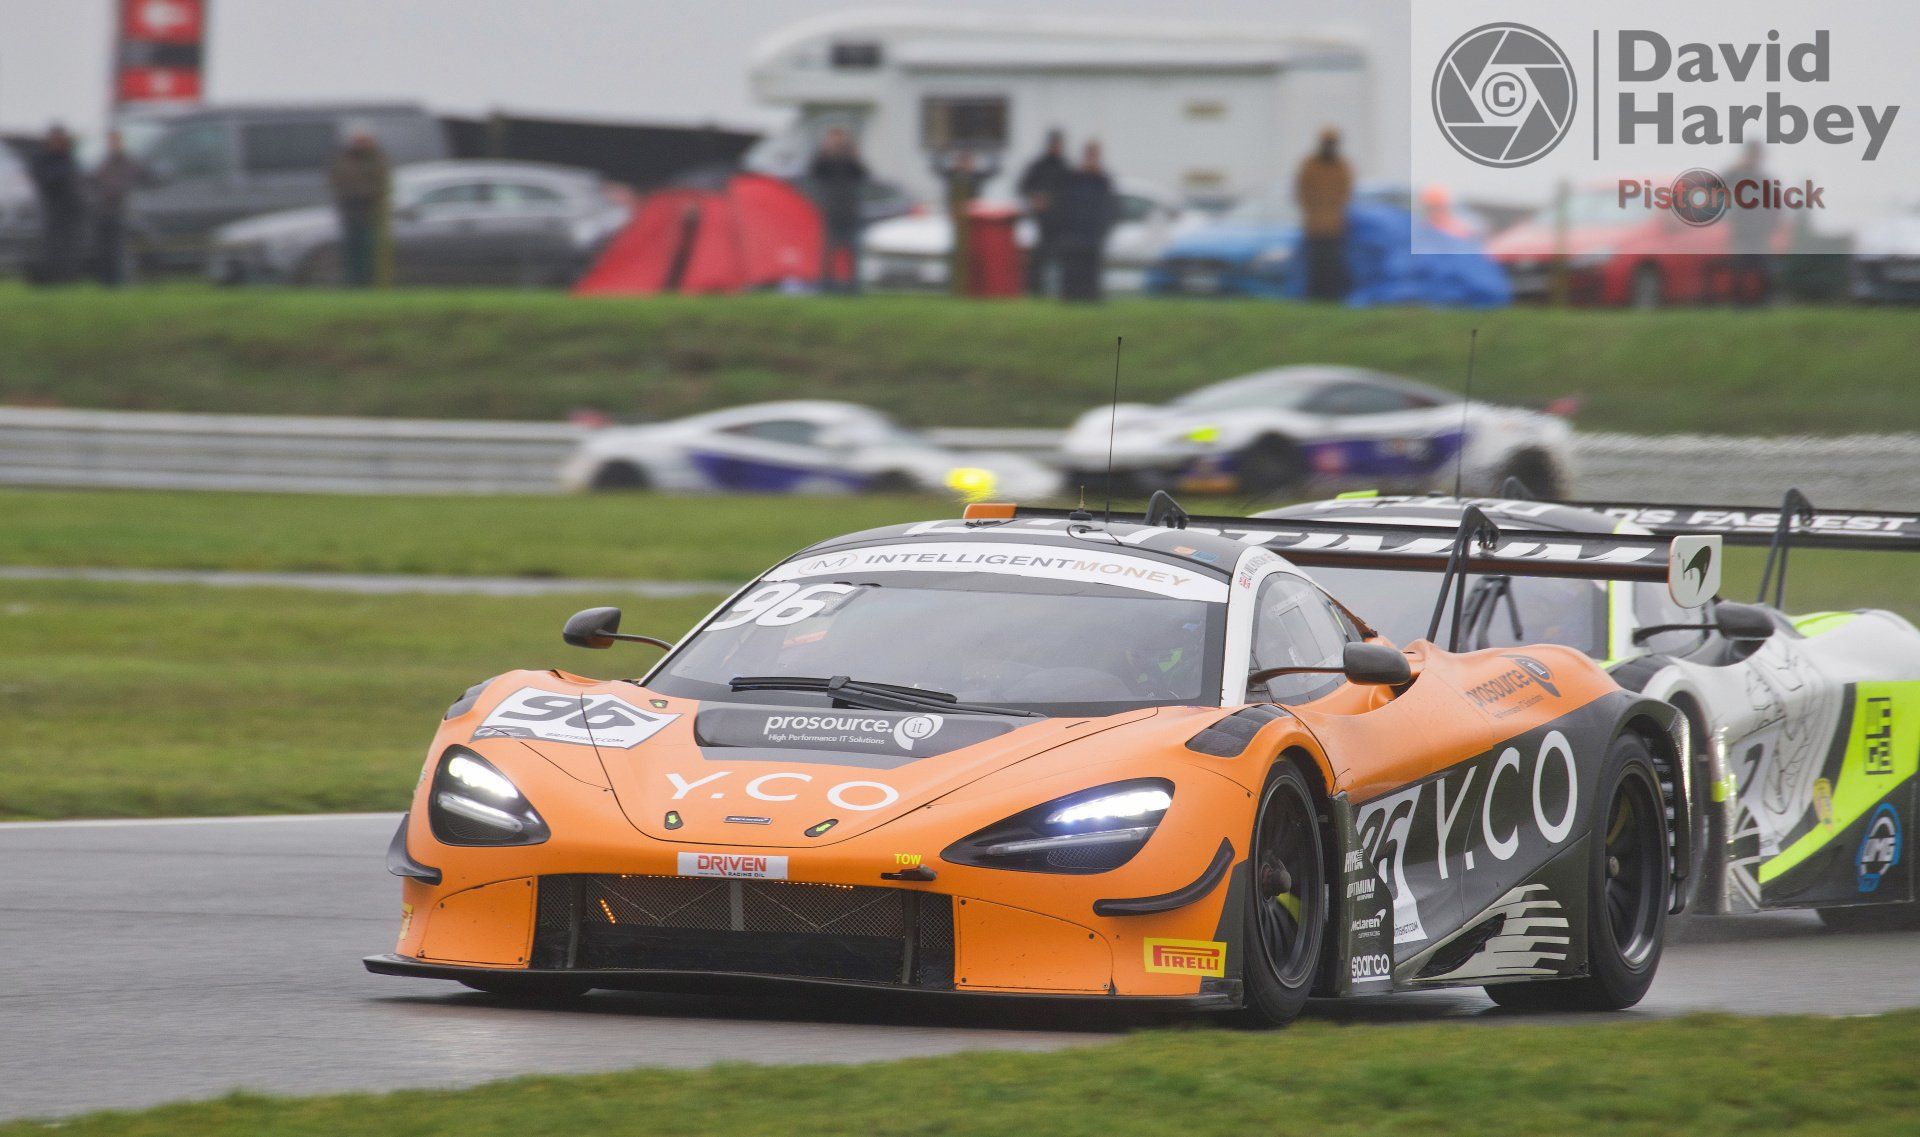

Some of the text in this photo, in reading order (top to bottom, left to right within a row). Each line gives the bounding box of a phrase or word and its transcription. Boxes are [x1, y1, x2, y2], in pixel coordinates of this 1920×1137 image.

[703, 582, 857, 631] 96
[499, 696, 660, 729] 96
[763, 715, 894, 735] prosource.
[768, 734, 886, 745] High Performance IT Solutions
[1436, 730, 1578, 880] Y.CO
[697, 855, 767, 875] DRIVEN
[894, 854, 922, 865] TOW
[1351, 917, 1380, 932] McLaren
[1153, 945, 1219, 970] PIRELLI
[1352, 953, 1390, 984] sparco
